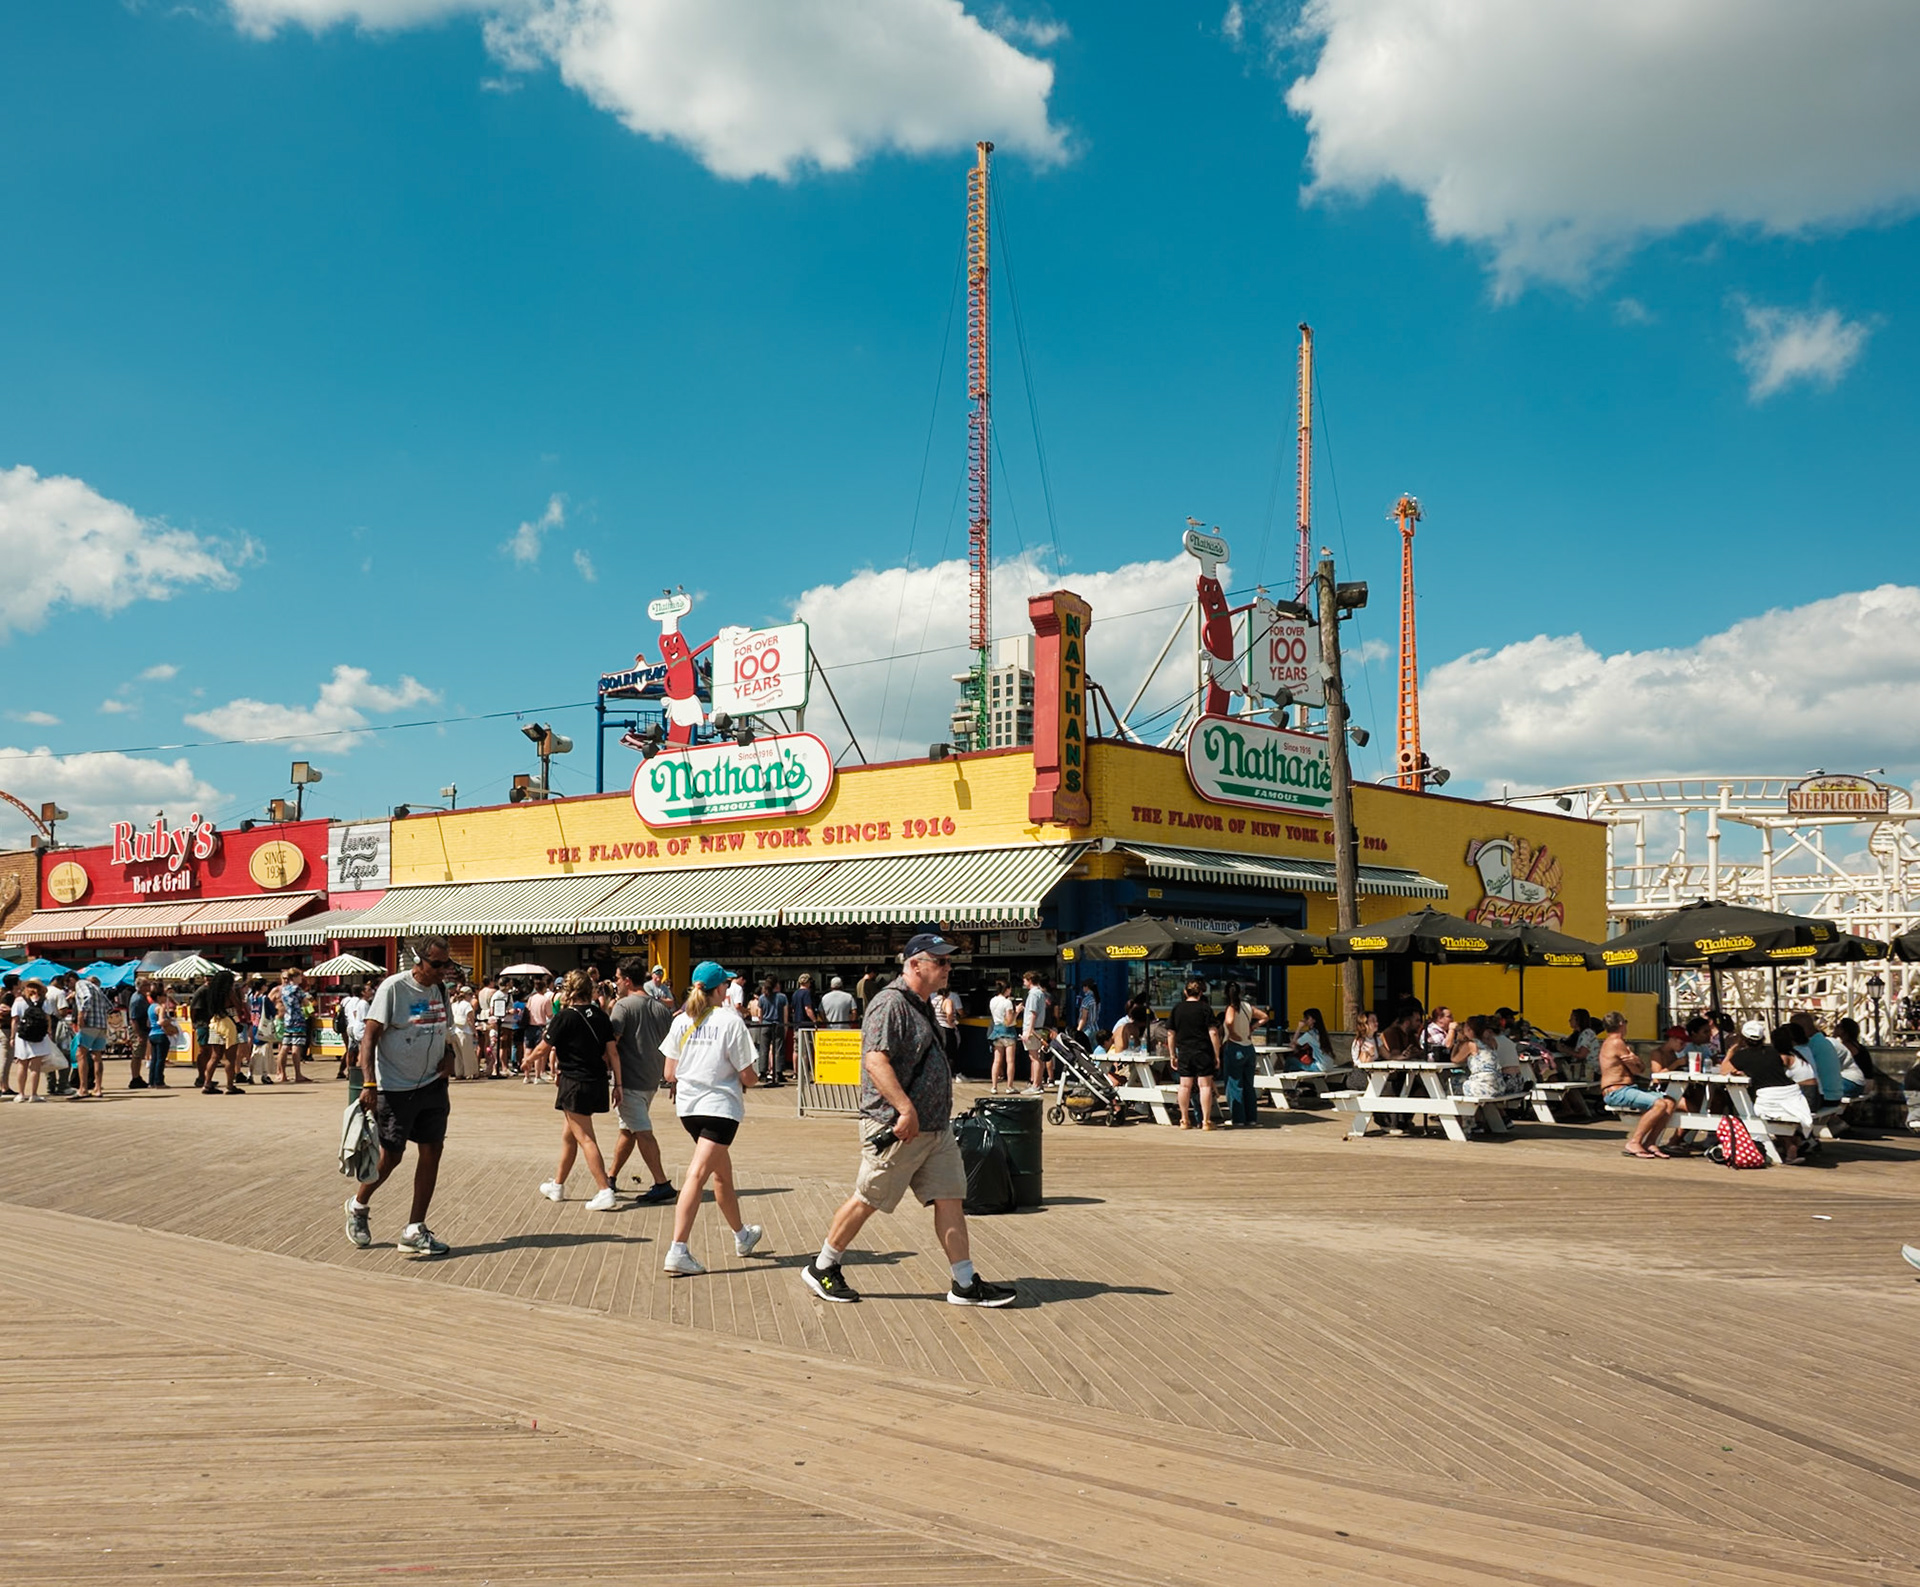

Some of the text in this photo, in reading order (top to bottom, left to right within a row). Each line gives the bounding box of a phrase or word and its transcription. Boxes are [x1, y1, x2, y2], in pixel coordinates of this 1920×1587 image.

[1270, 626, 1305, 636] FOR OVER
[734, 635, 778, 658] FOR OVER
[1270, 637, 1307, 664] 100
[734, 648, 780, 683] 100
[1269, 666, 1307, 681] YEARS
[734, 673, 781, 699] YEARS
[1065, 613, 1081, 792] NATHANS
[738, 749, 774, 761] Since 1916
[1284, 742, 1311, 755] Since 1916
[650, 748, 812, 802] Nathan's
[1254, 789, 1299, 802] FAMOUS
[1790, 792, 1886, 810] STEEPLECHASE
[703, 801, 756, 813] FAMOUS
[1131, 806, 1163, 824] THE
[1168, 810, 1224, 831] FLAVOR
[1228, 818, 1246, 834] OF
[1251, 821, 1281, 838] NEW
[1285, 825, 1319, 843] YORK
[110, 812, 214, 871] Ruby's
[547, 816, 956, 864] THE FLAVOR OF NEW YORK SINCE 1916
[1363, 835, 1388, 852] 1916
[264, 850, 287, 865] SINCE
[131, 876, 152, 894] Bar
[162, 870, 190, 892] Grill
[1106, 945, 1148, 957] Nathan's
[1350, 937, 1388, 949] Nathan's
[1440, 936, 1489, 950] Nathan's
[1695, 935, 1756, 954] Nathan's
[1602, 949, 1638, 964] Nathan's
